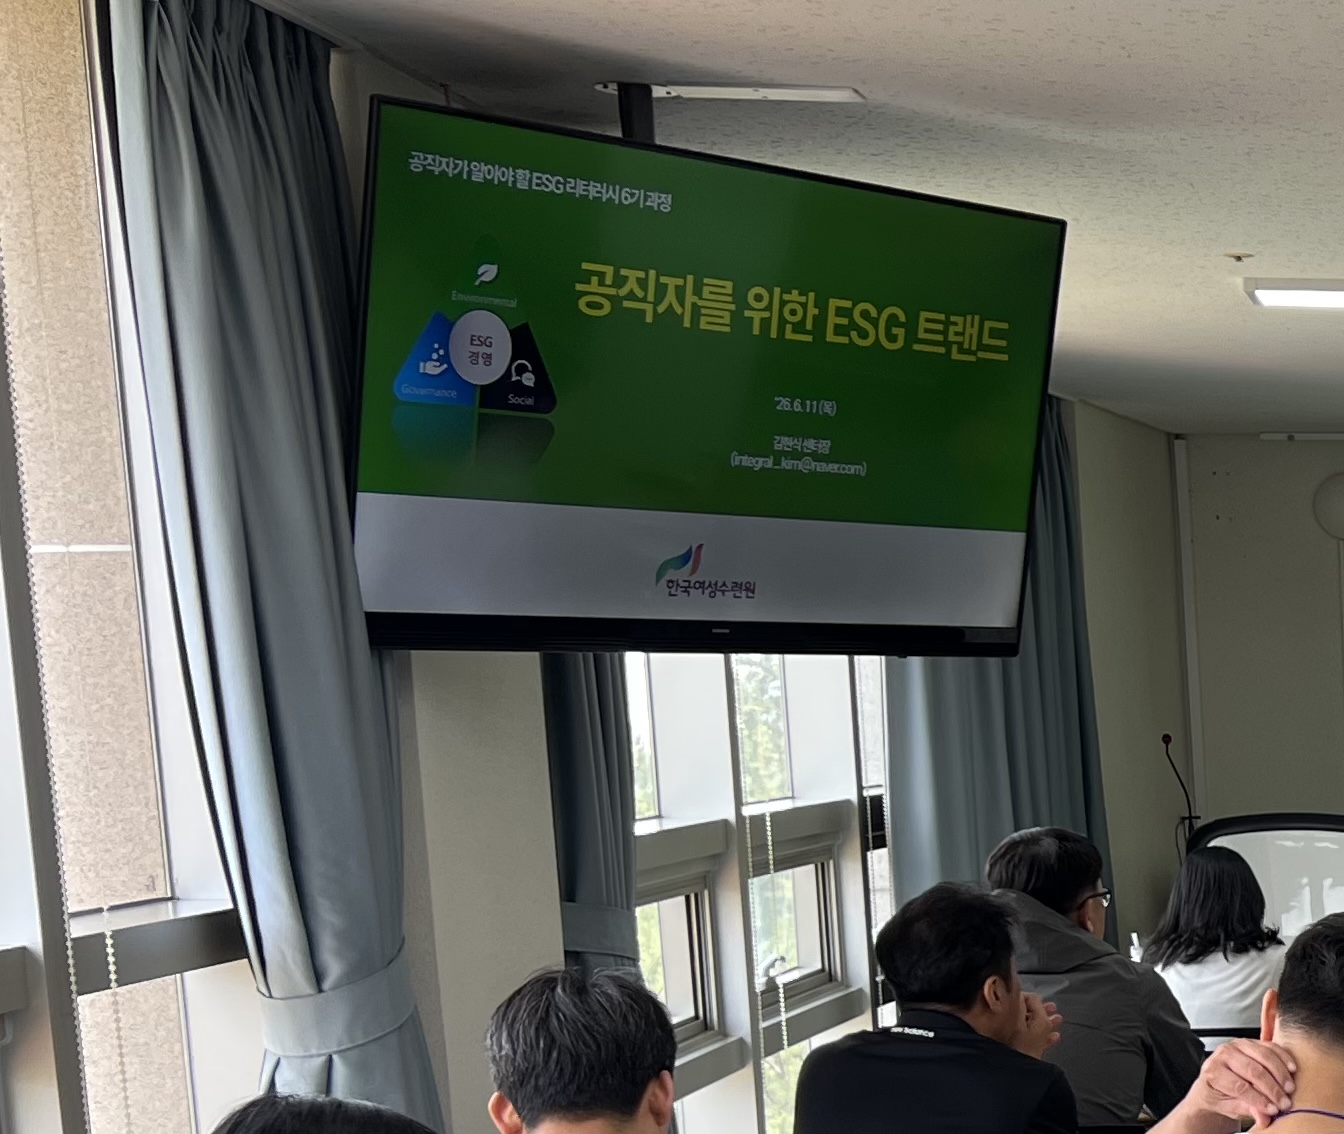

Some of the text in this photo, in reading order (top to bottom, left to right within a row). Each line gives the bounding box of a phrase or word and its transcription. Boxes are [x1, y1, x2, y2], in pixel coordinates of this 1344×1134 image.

[408, 151, 673, 212] 공직자가 알아야 할 ESG 리터러시 6기 과정
[574, 261, 1010, 362] 공직자를 위한 ESG 트랜드
[469, 334, 493, 348] ESG
[467, 351, 493, 367] 경영
[507, 394, 535, 406] Social
[666, 579, 756, 599] 한국여성수련원
